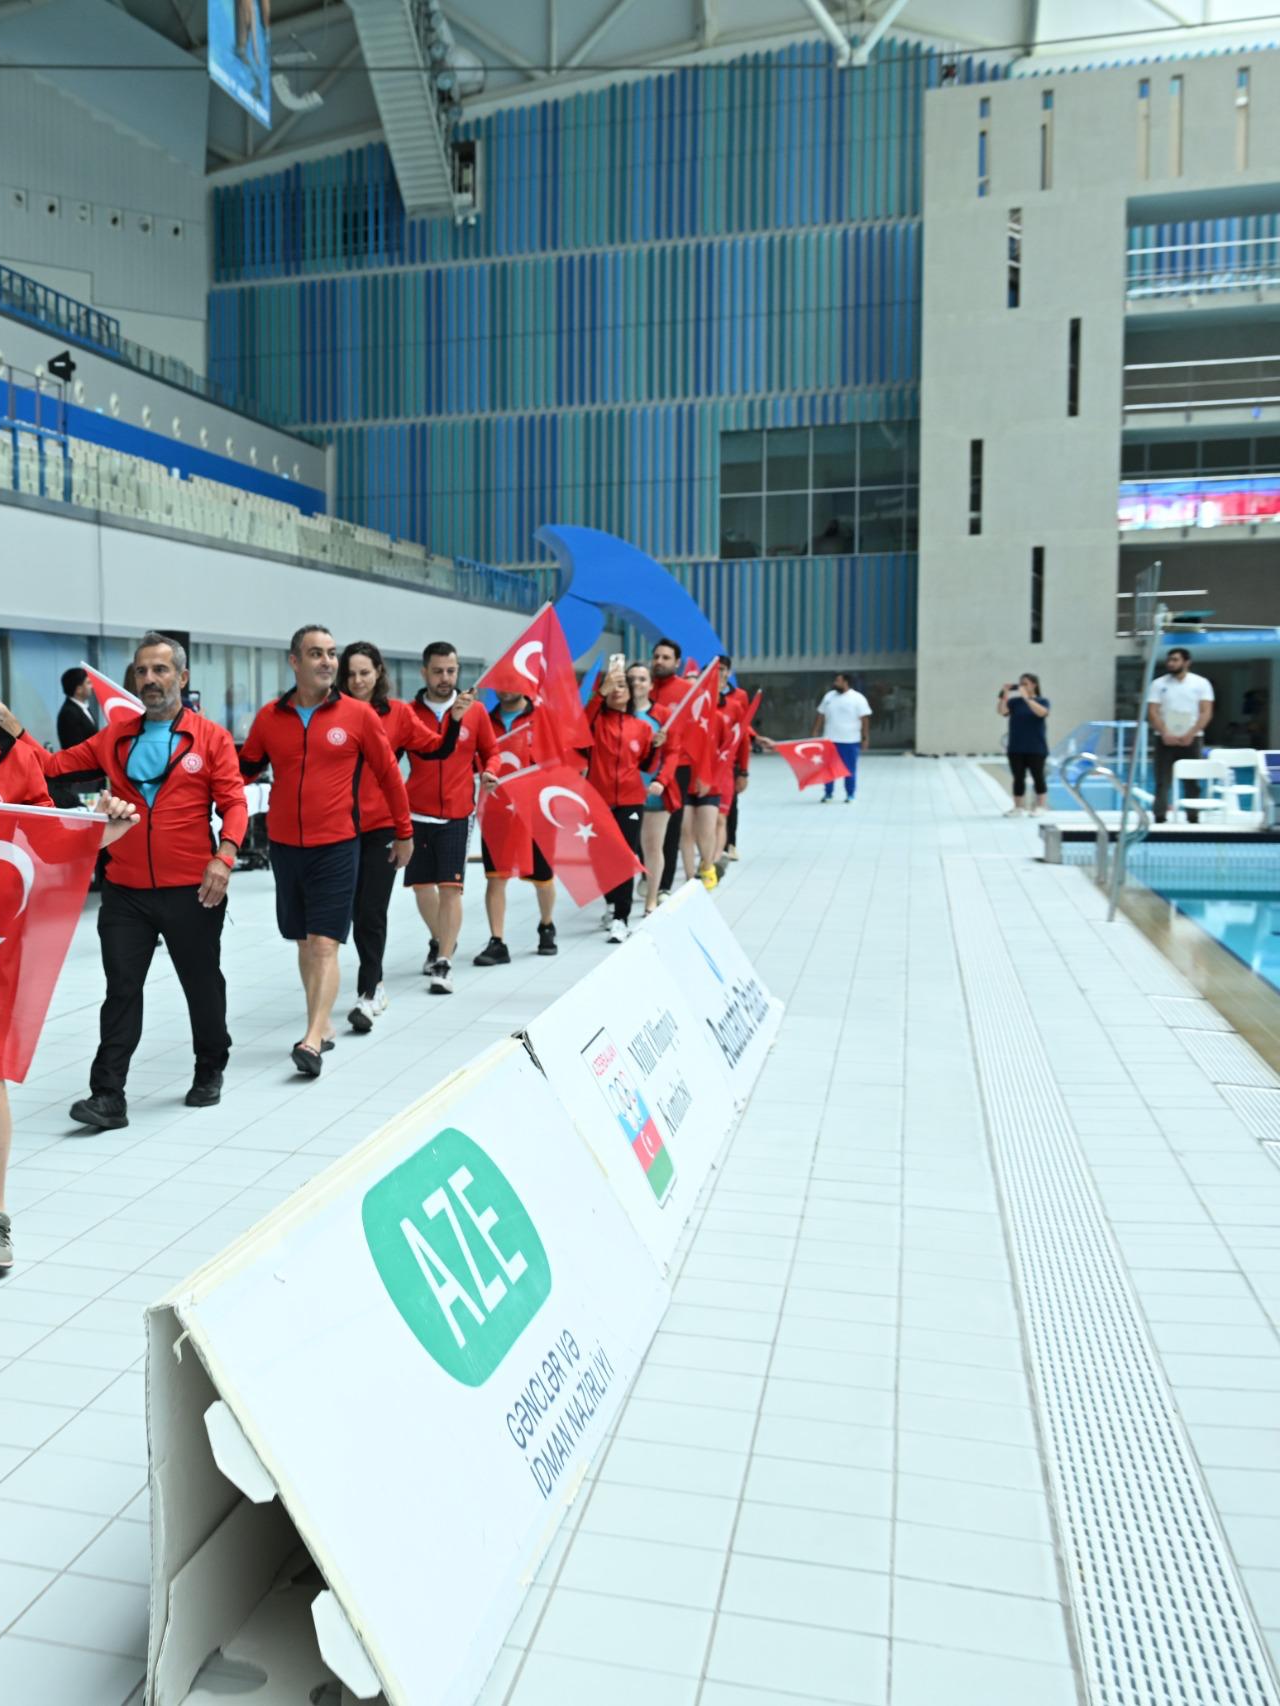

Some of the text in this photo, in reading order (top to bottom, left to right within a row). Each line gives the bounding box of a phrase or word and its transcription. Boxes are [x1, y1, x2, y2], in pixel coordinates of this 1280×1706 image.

[399, 1165, 528, 1349] AZE
[506, 1329, 581, 1450] GƏNCLƏR VƏ
[524, 1338, 615, 1501] İDMAN NAZİRLİYİ
